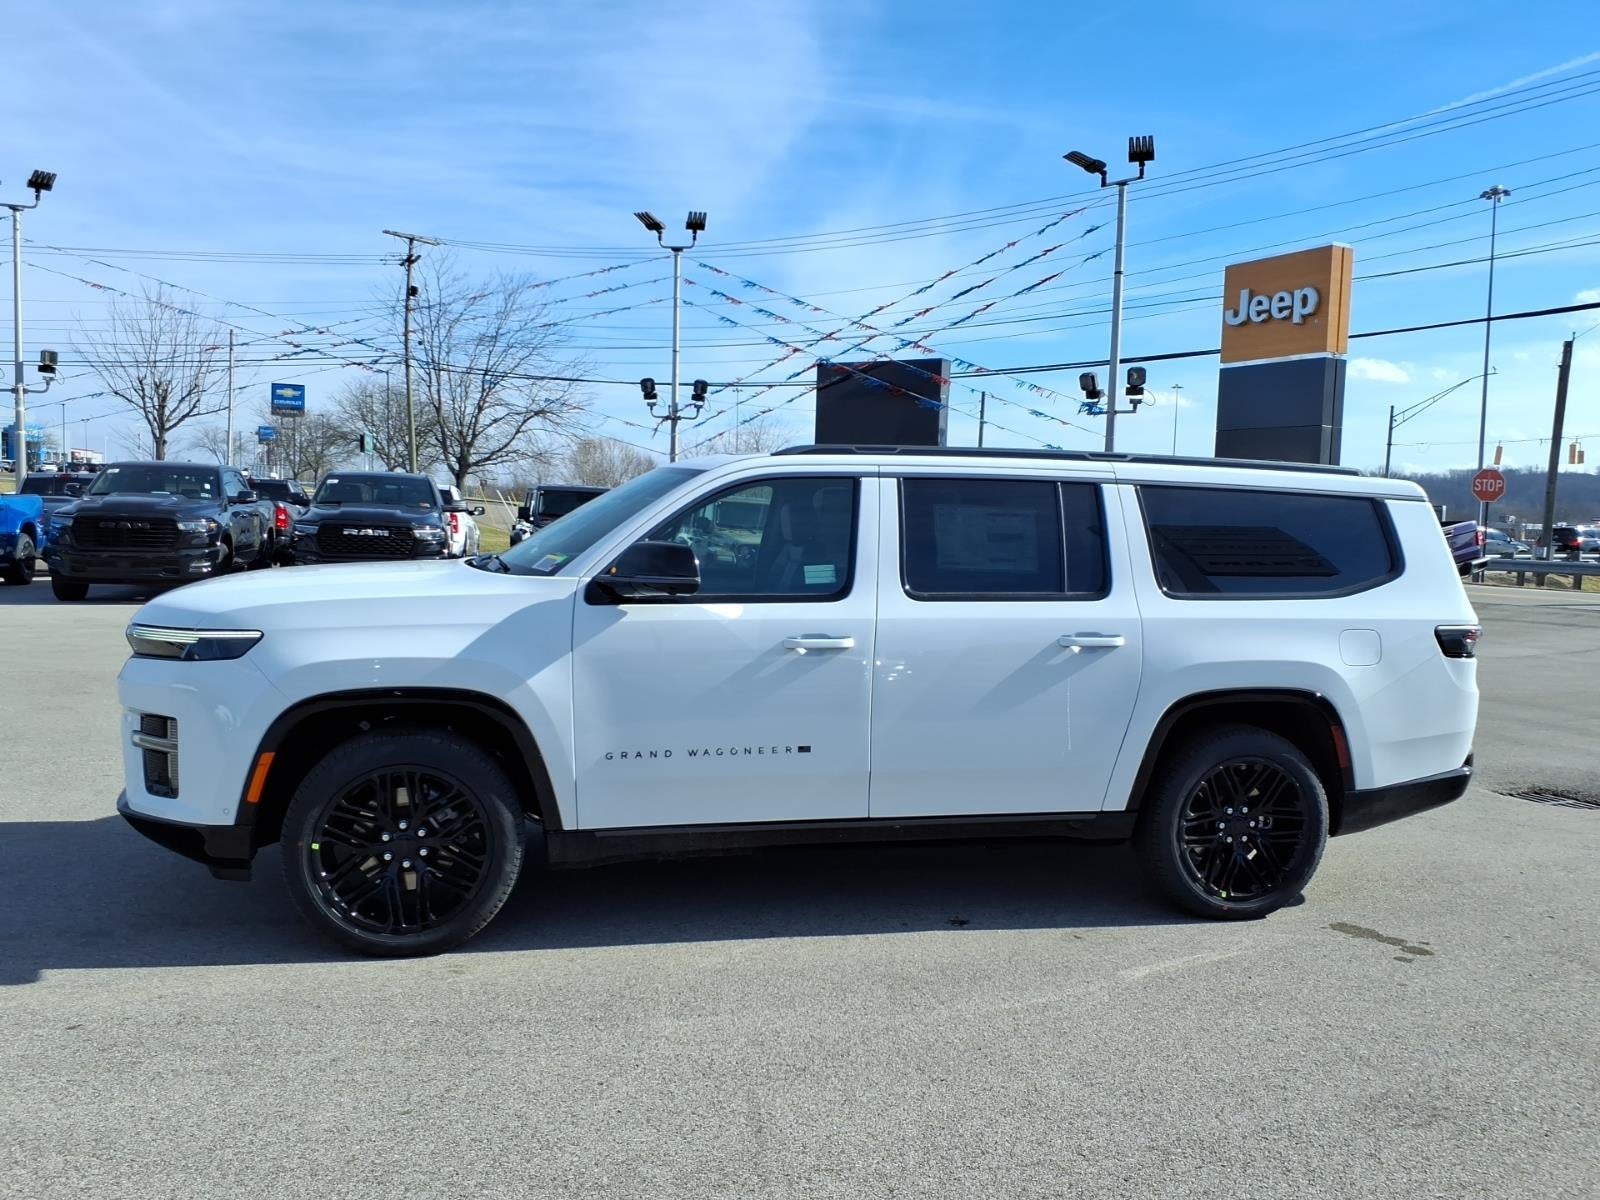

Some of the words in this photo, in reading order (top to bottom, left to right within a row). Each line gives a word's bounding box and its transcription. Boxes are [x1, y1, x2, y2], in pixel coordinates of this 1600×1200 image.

[1224, 286, 1320, 326] Jeep
[1474, 479, 1504, 492] STOP
[343, 528, 390, 537] RAM
[605, 749, 673, 760] GRAND
[687, 745, 793, 757] WAGONEER
